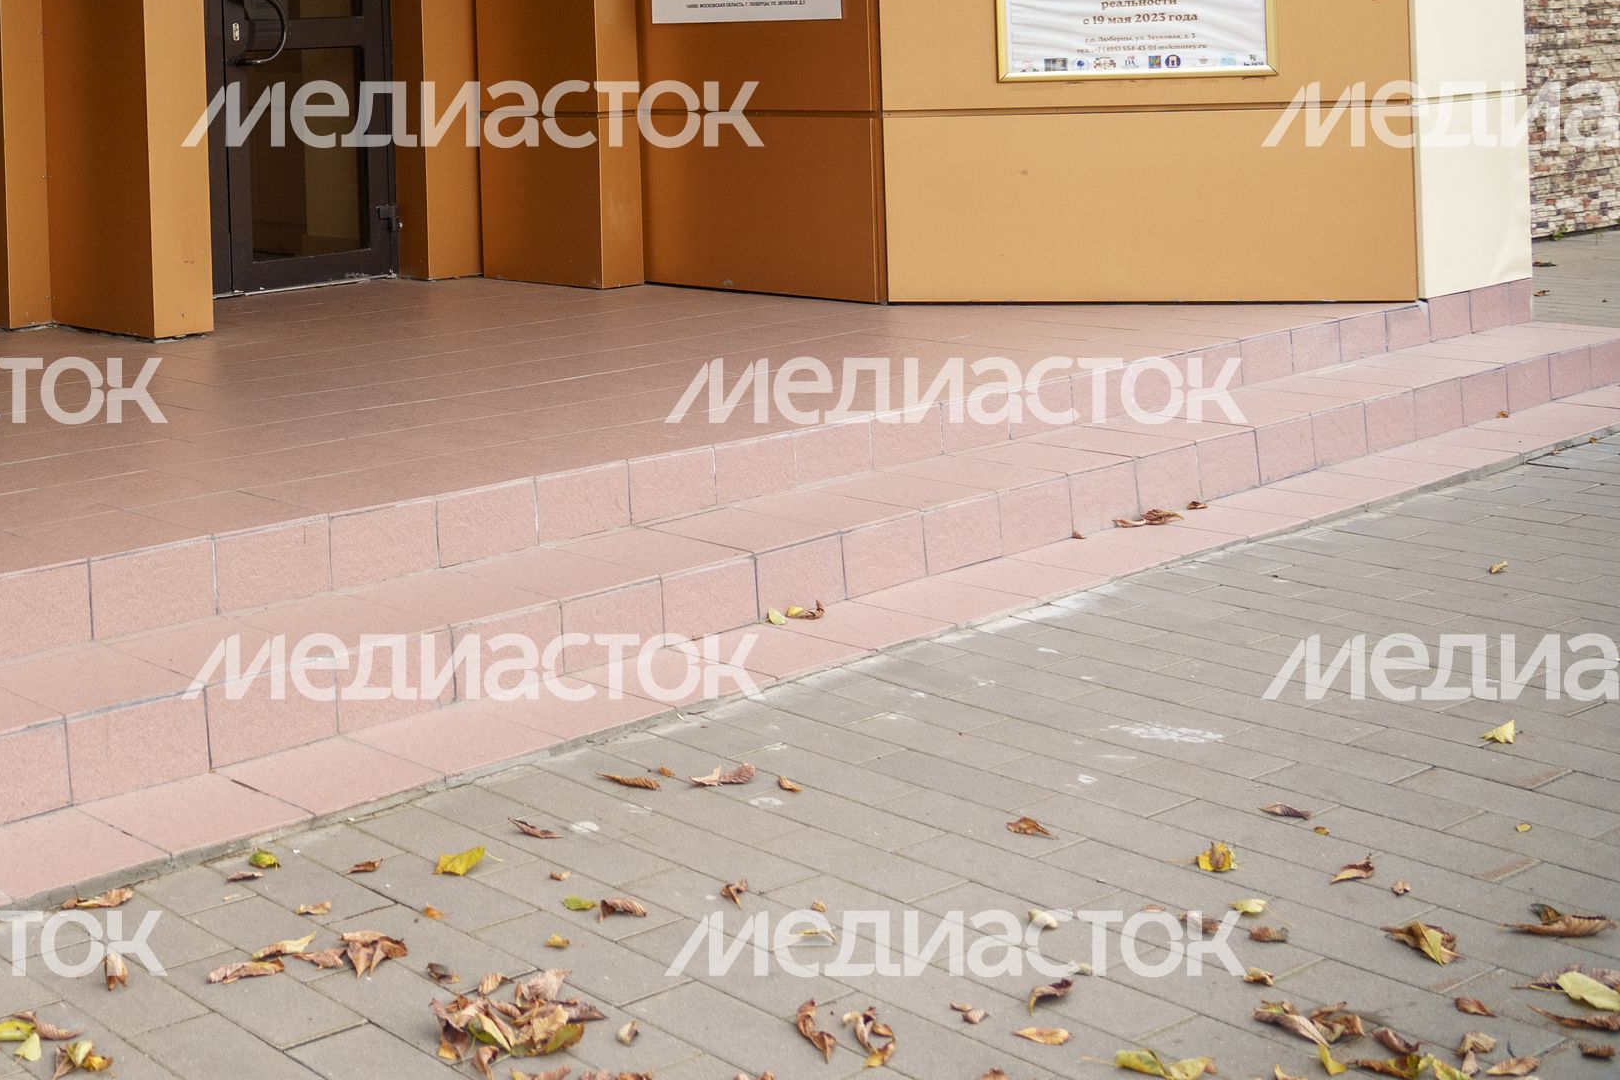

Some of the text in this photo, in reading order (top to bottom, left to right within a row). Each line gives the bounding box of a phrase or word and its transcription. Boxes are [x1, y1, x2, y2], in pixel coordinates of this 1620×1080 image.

[1092, 15, 1105, 25] 19
[1107, 16, 1132, 24] мая
[1135, 12, 1166, 23] 2023
[1168, 13, 1198, 22] года
